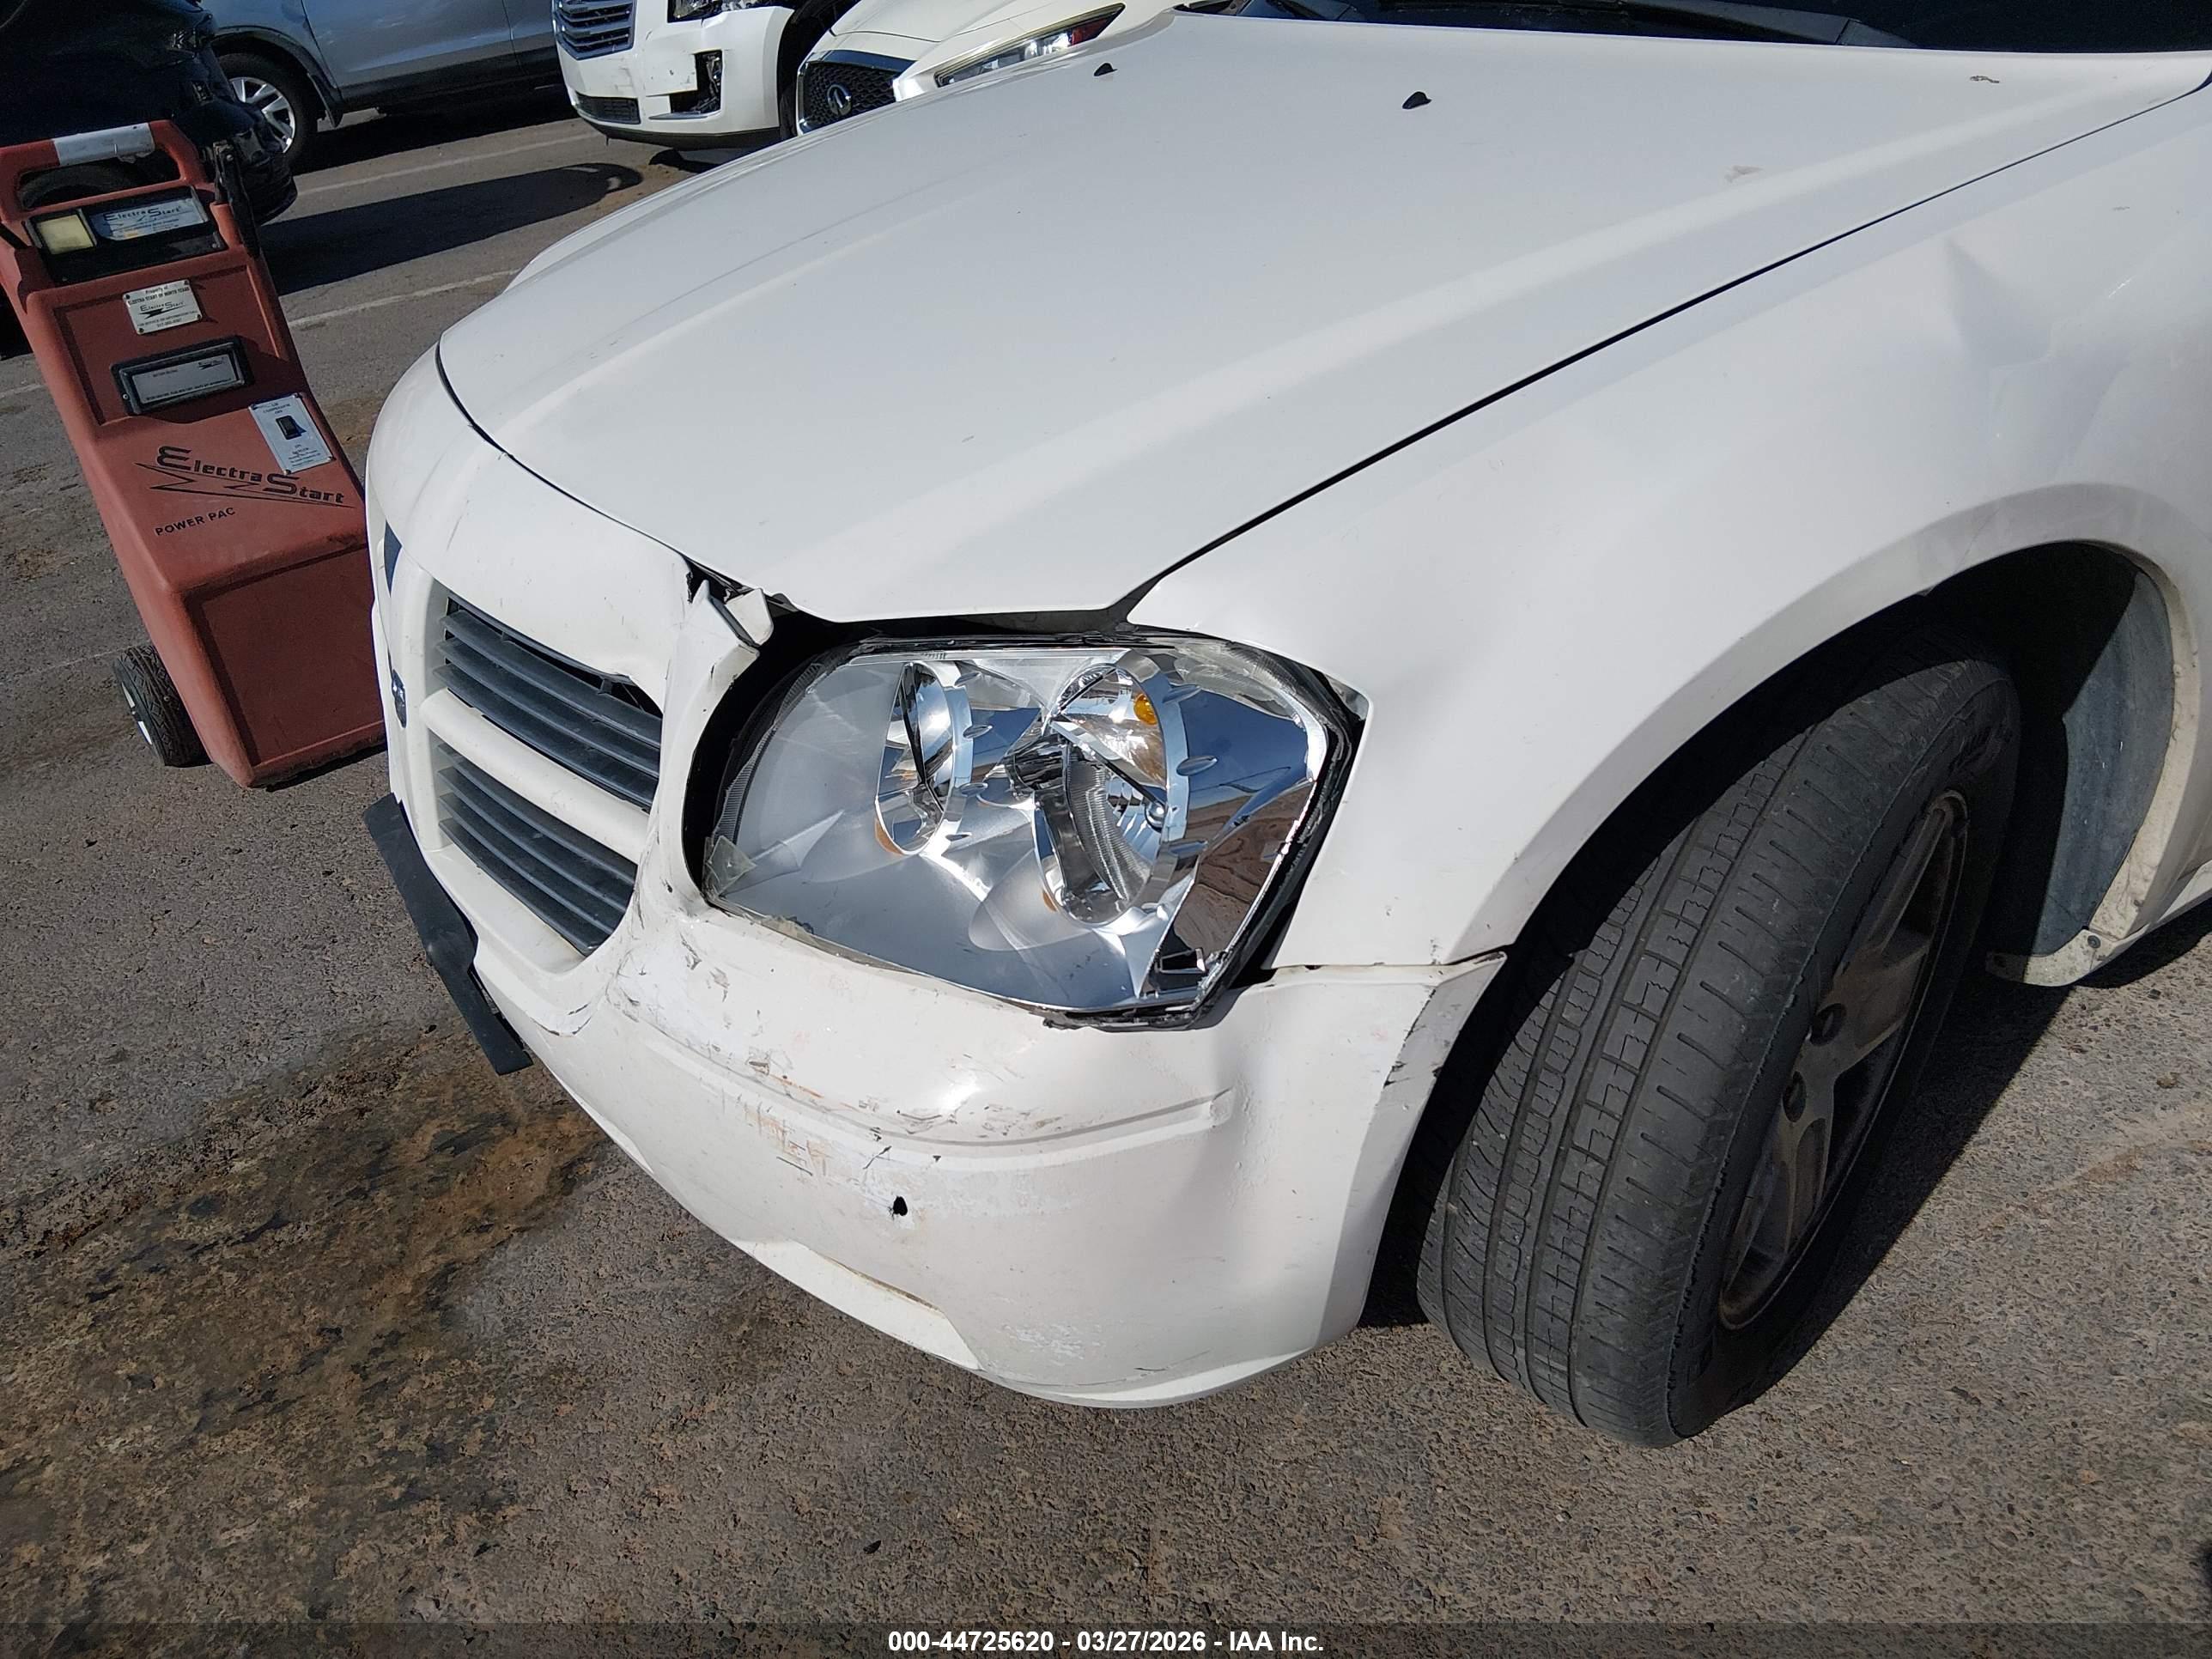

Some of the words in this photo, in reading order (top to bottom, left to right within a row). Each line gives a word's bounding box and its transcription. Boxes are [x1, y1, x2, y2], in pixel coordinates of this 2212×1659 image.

[103, 210, 146, 222] Electra
[147, 207, 179, 217] Start
[156, 446, 263, 483] Electra
[262, 473, 344, 503] Start
[155, 515, 206, 536] POWER
[208, 507, 235, 521] PAC
